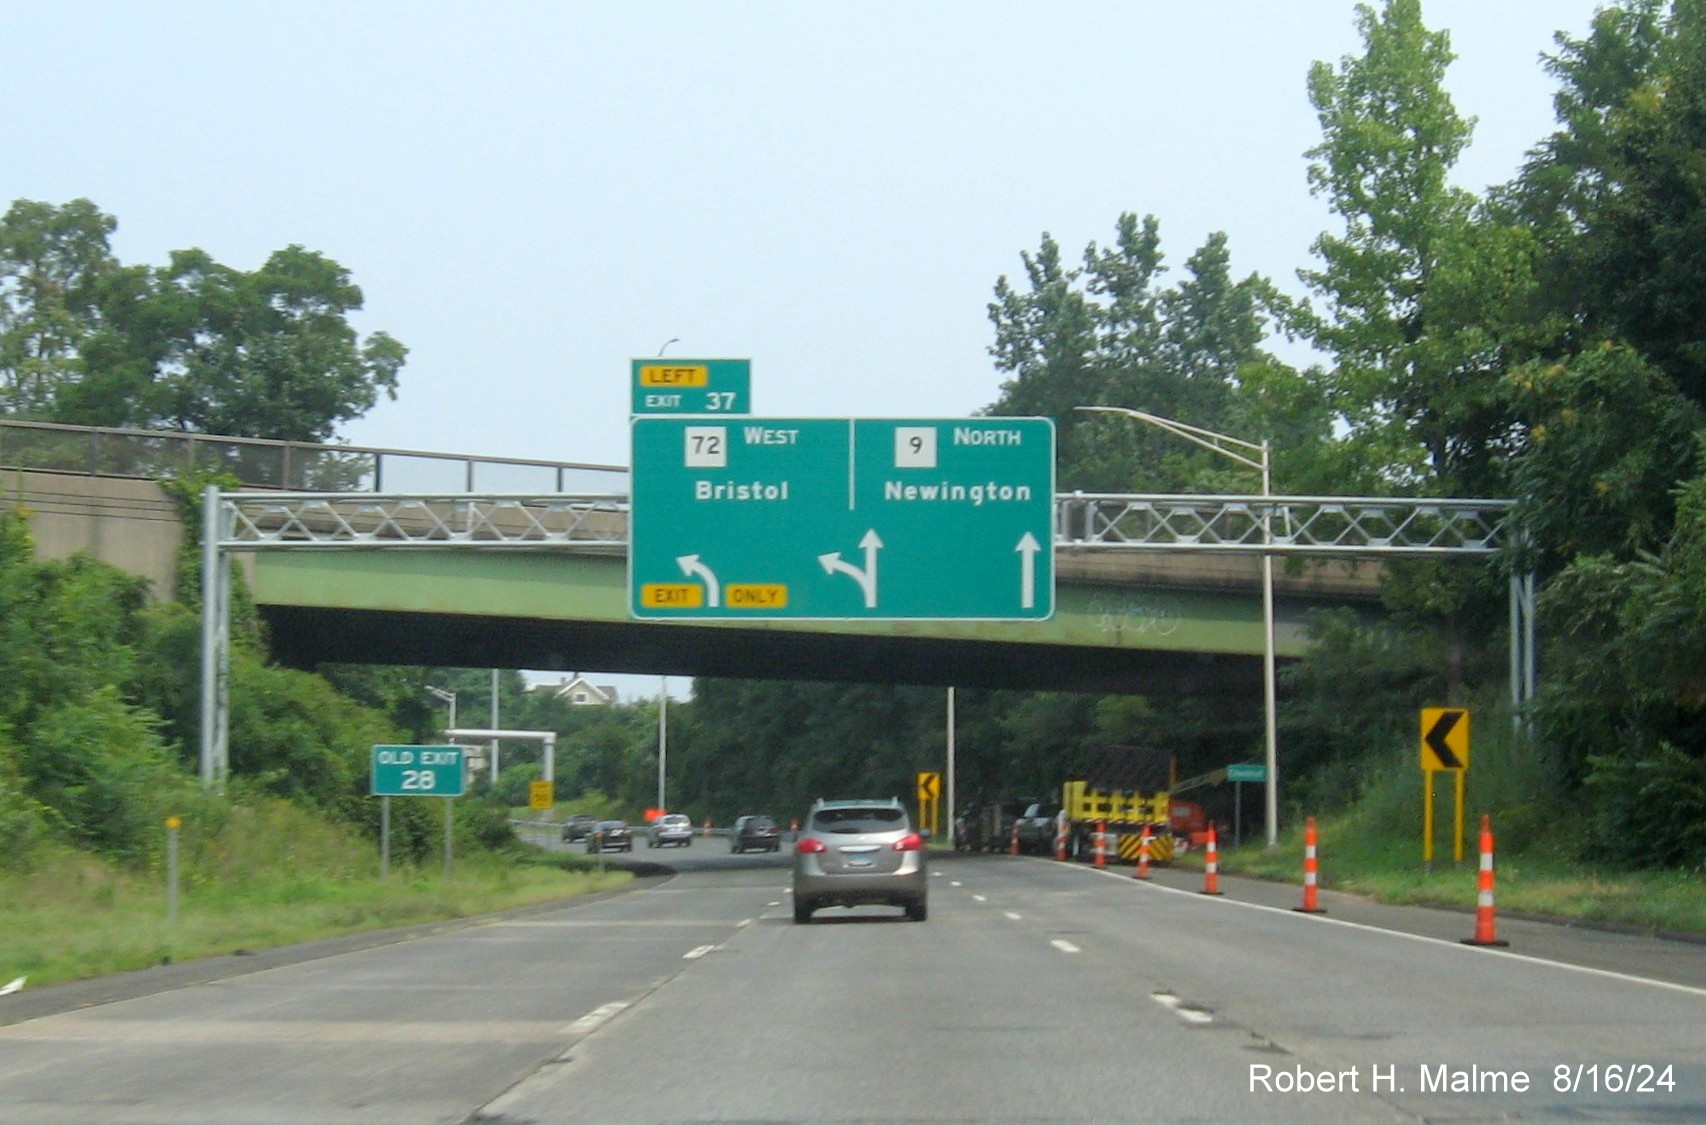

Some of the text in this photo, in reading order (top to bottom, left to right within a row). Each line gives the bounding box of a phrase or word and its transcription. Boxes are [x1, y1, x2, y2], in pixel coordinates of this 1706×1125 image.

[649, 369, 697, 384] LEFT
[645, 392, 736, 410] EXIT 37
[691, 436, 721, 455] 72
[910, 437, 923, 454] 9
[695, 481, 790, 501] Bristol
[884, 481, 1032, 507] Newington
[654, 588, 778, 604] EXIT ONLY
[379, 751, 460, 766] OLD EXIT
[401, 770, 435, 790] 28
